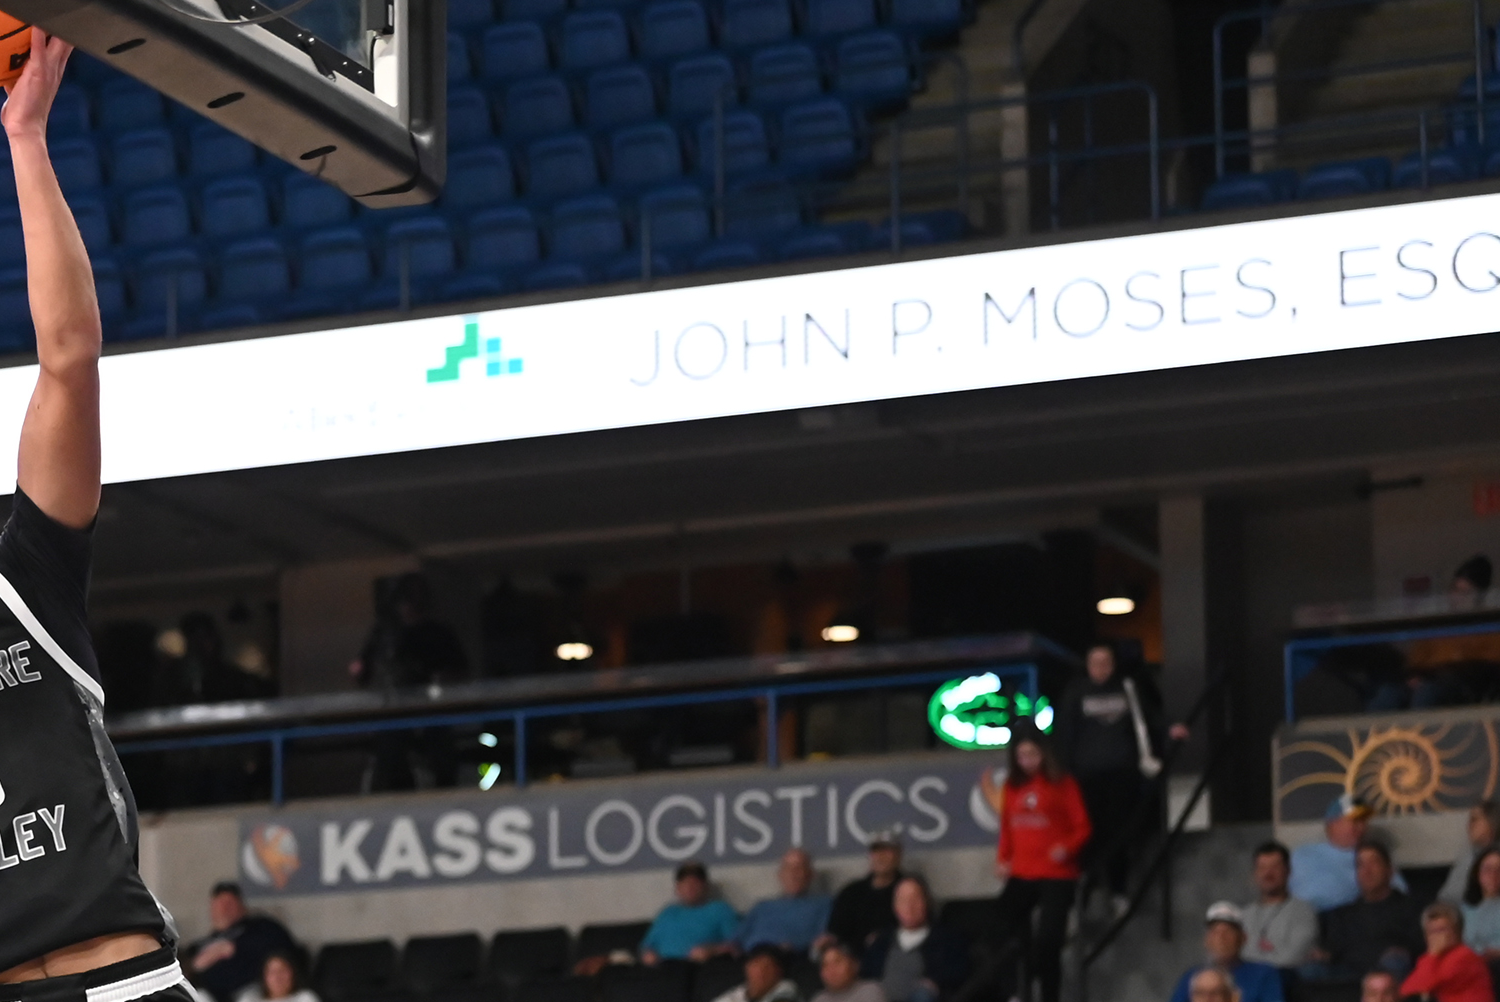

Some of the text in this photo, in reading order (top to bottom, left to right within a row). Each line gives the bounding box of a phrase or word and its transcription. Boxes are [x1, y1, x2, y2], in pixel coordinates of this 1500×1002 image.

[629, 231, 1500, 387] JOHN P. MOSES, ESQ
[320, 776, 949, 886] KASS LOGISTICS
